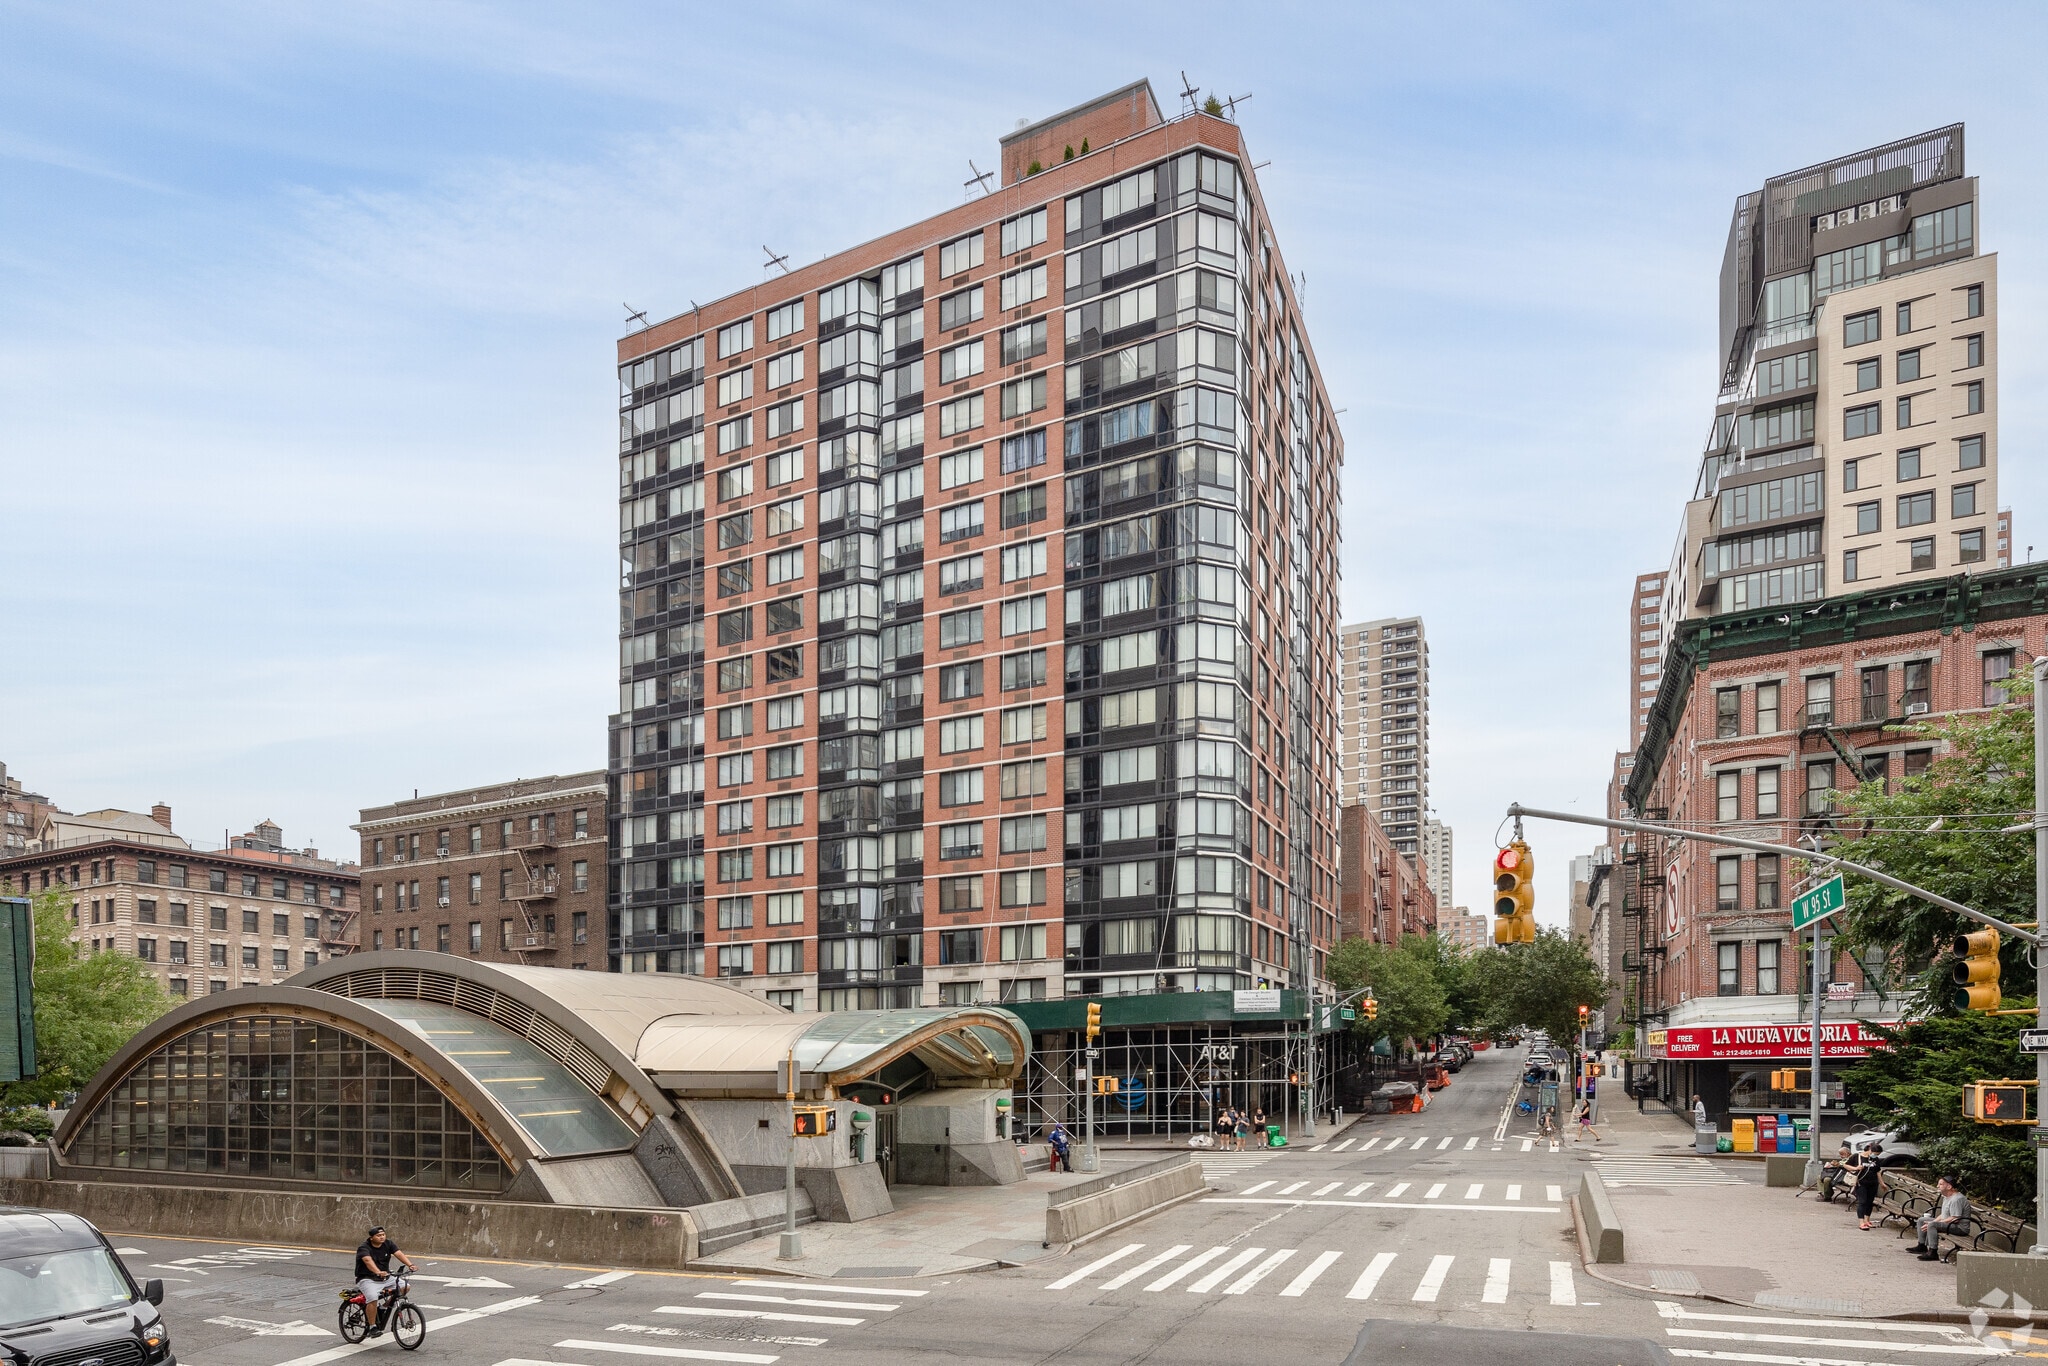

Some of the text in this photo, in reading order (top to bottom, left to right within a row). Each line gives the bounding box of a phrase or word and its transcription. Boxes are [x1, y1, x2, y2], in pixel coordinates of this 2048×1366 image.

[1802, 888, 1831, 919] W 95 St
[1829, 985, 1854, 993] AWC
[1712, 1029, 1731, 1044] LA
[1736, 1027, 1781, 1043] NUEVA
[1200, 1045, 1239, 1060] AT&T
[1671, 1044, 1700, 1052] DELIVERY
[1783, 1046, 1826, 1055] CHINEE
